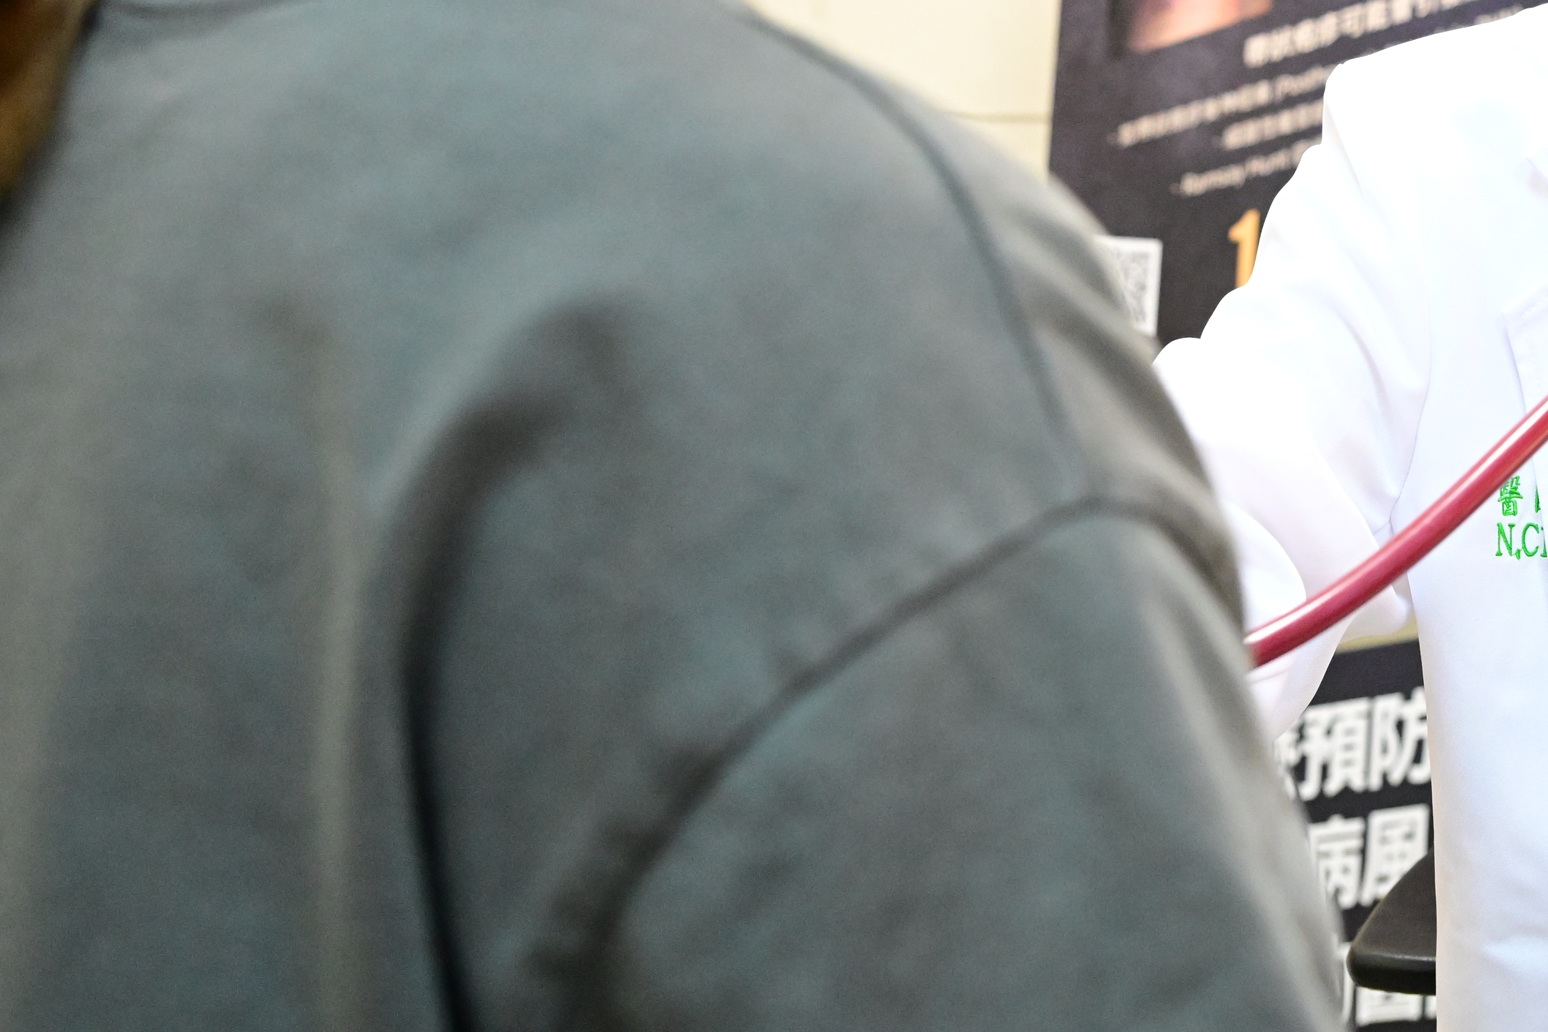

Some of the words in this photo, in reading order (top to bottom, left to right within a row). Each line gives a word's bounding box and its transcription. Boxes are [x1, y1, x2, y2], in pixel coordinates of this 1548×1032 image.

[1498, 475, 1541, 515] 醫
[1495, 522, 1548, 560] N,C
[1273, 685, 1431, 799] 預防
